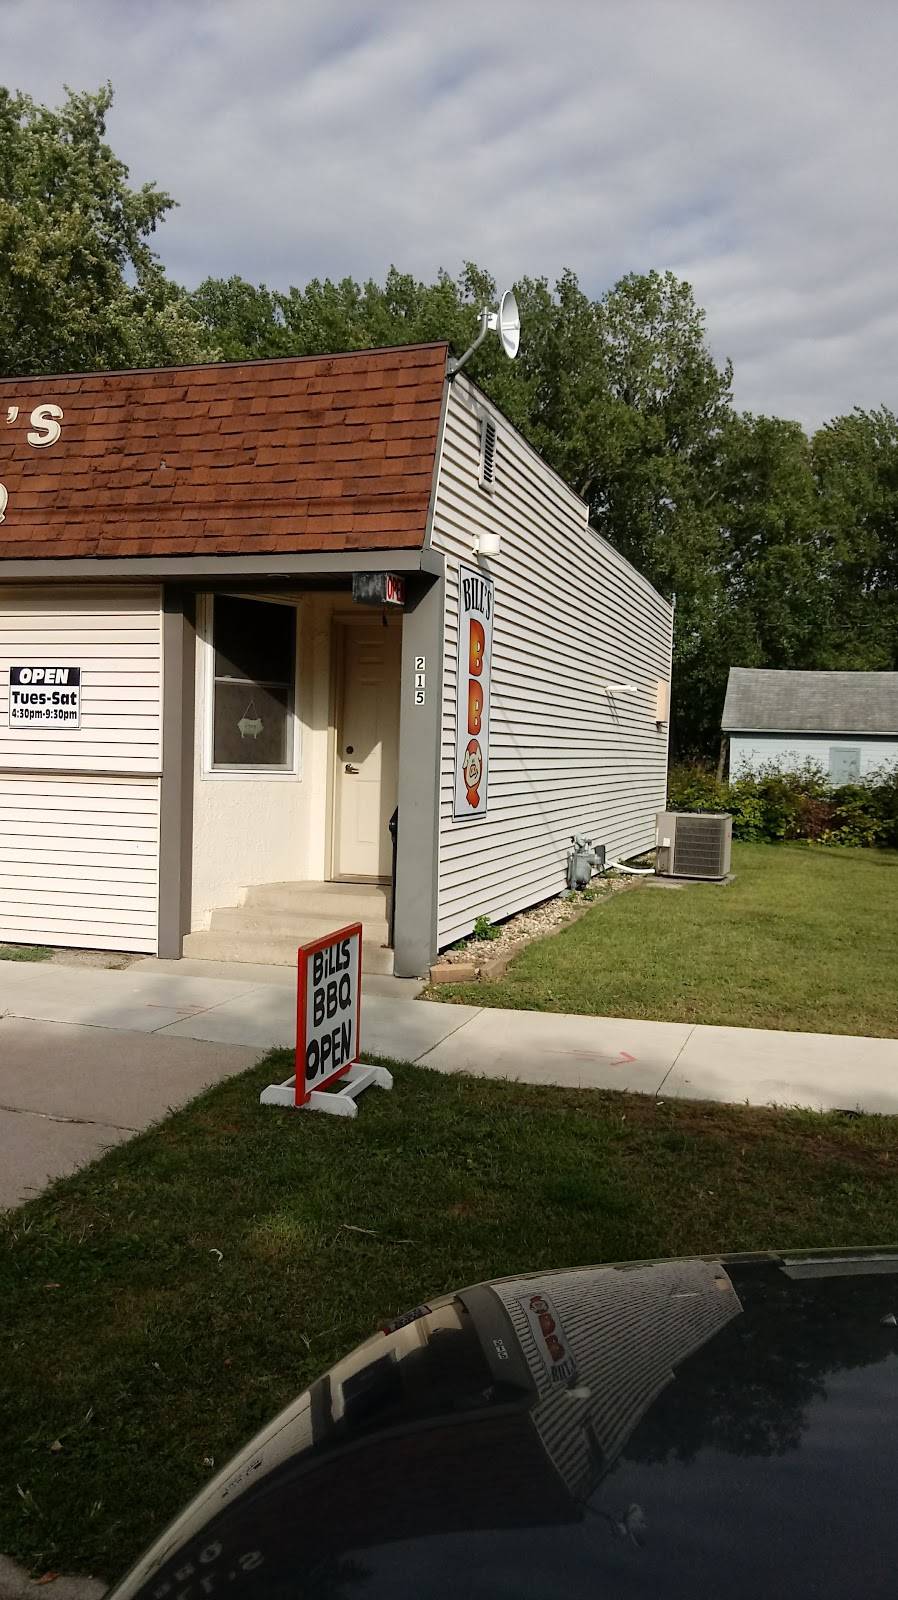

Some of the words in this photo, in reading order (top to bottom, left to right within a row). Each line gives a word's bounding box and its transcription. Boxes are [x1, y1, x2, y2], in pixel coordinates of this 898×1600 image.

[462, 577, 492, 620] BILL'S
[19, 668, 69, 684] OPEN
[12, 691, 77, 705] Tues-Sat
[12, 708, 77, 720] 4:30pm-9:30pm
[313, 973, 352, 1027] BBQ
[305, 1019, 352, 1080] OPEN
